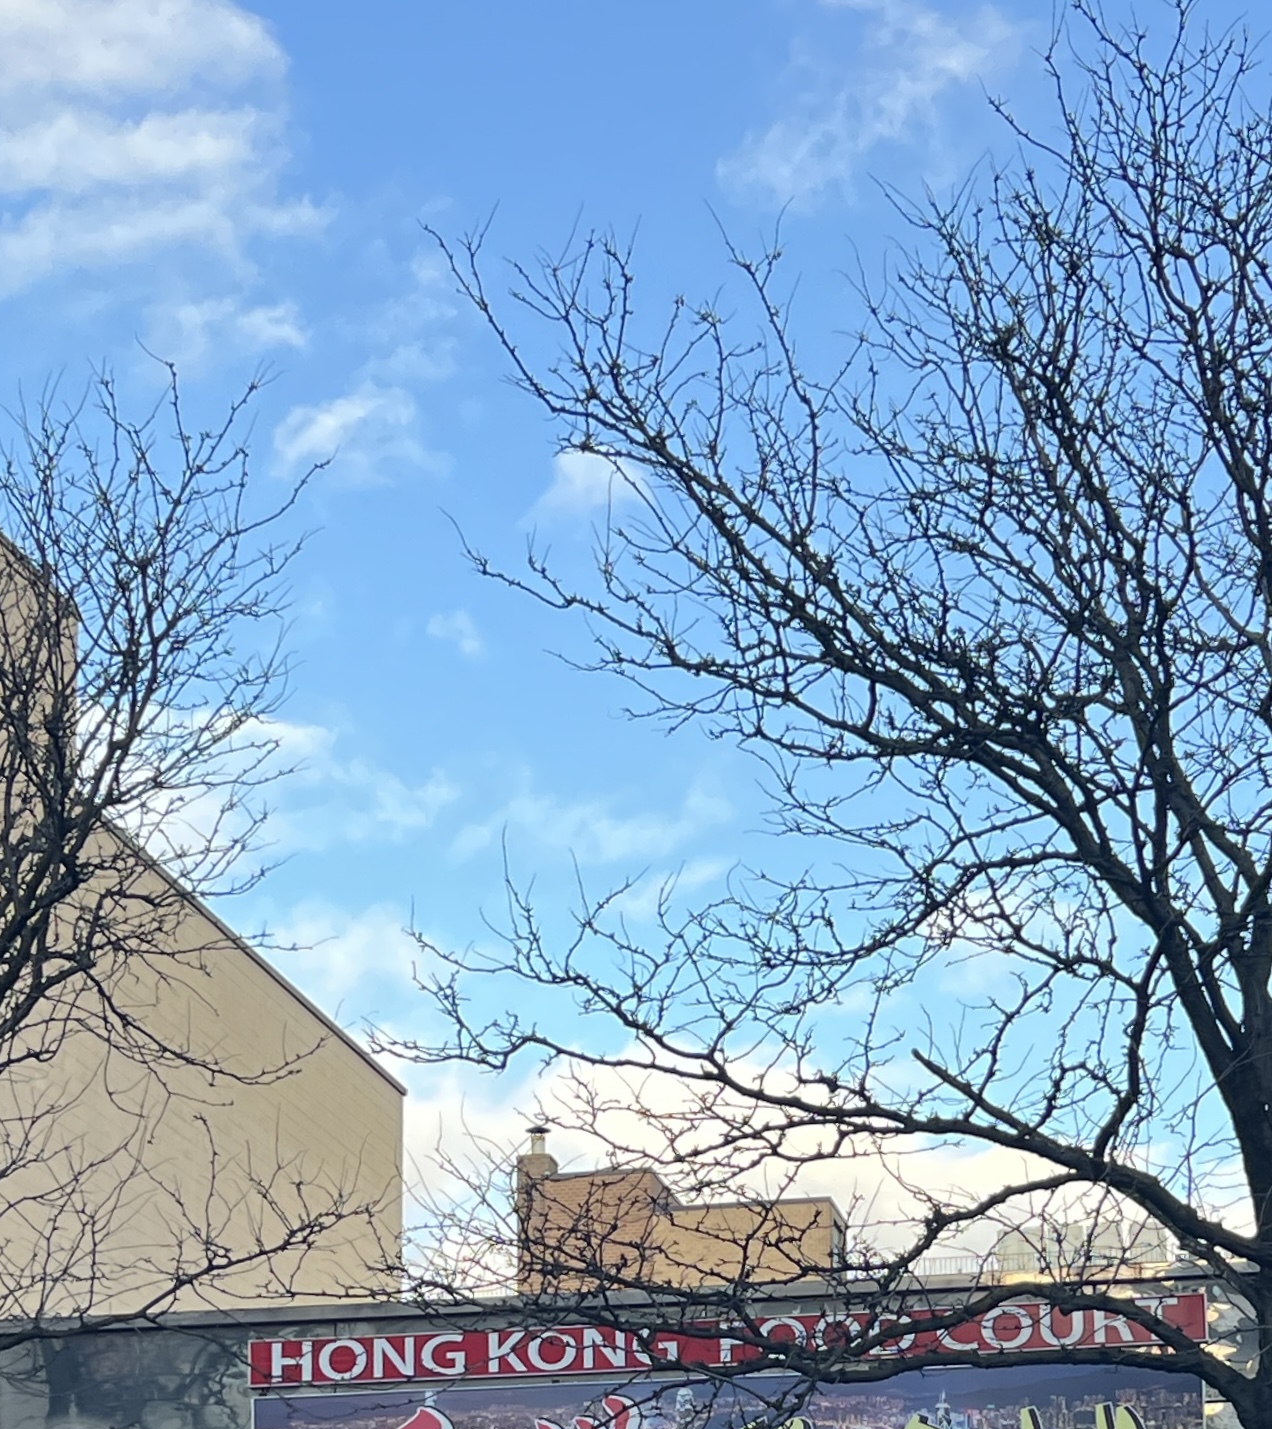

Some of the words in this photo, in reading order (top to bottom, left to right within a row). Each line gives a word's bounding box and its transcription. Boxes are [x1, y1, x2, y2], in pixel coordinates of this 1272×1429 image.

[270, 1333, 466, 1382] HONG
[488, 1326, 678, 1374] KONG
[937, 1297, 1178, 1350] COURT
